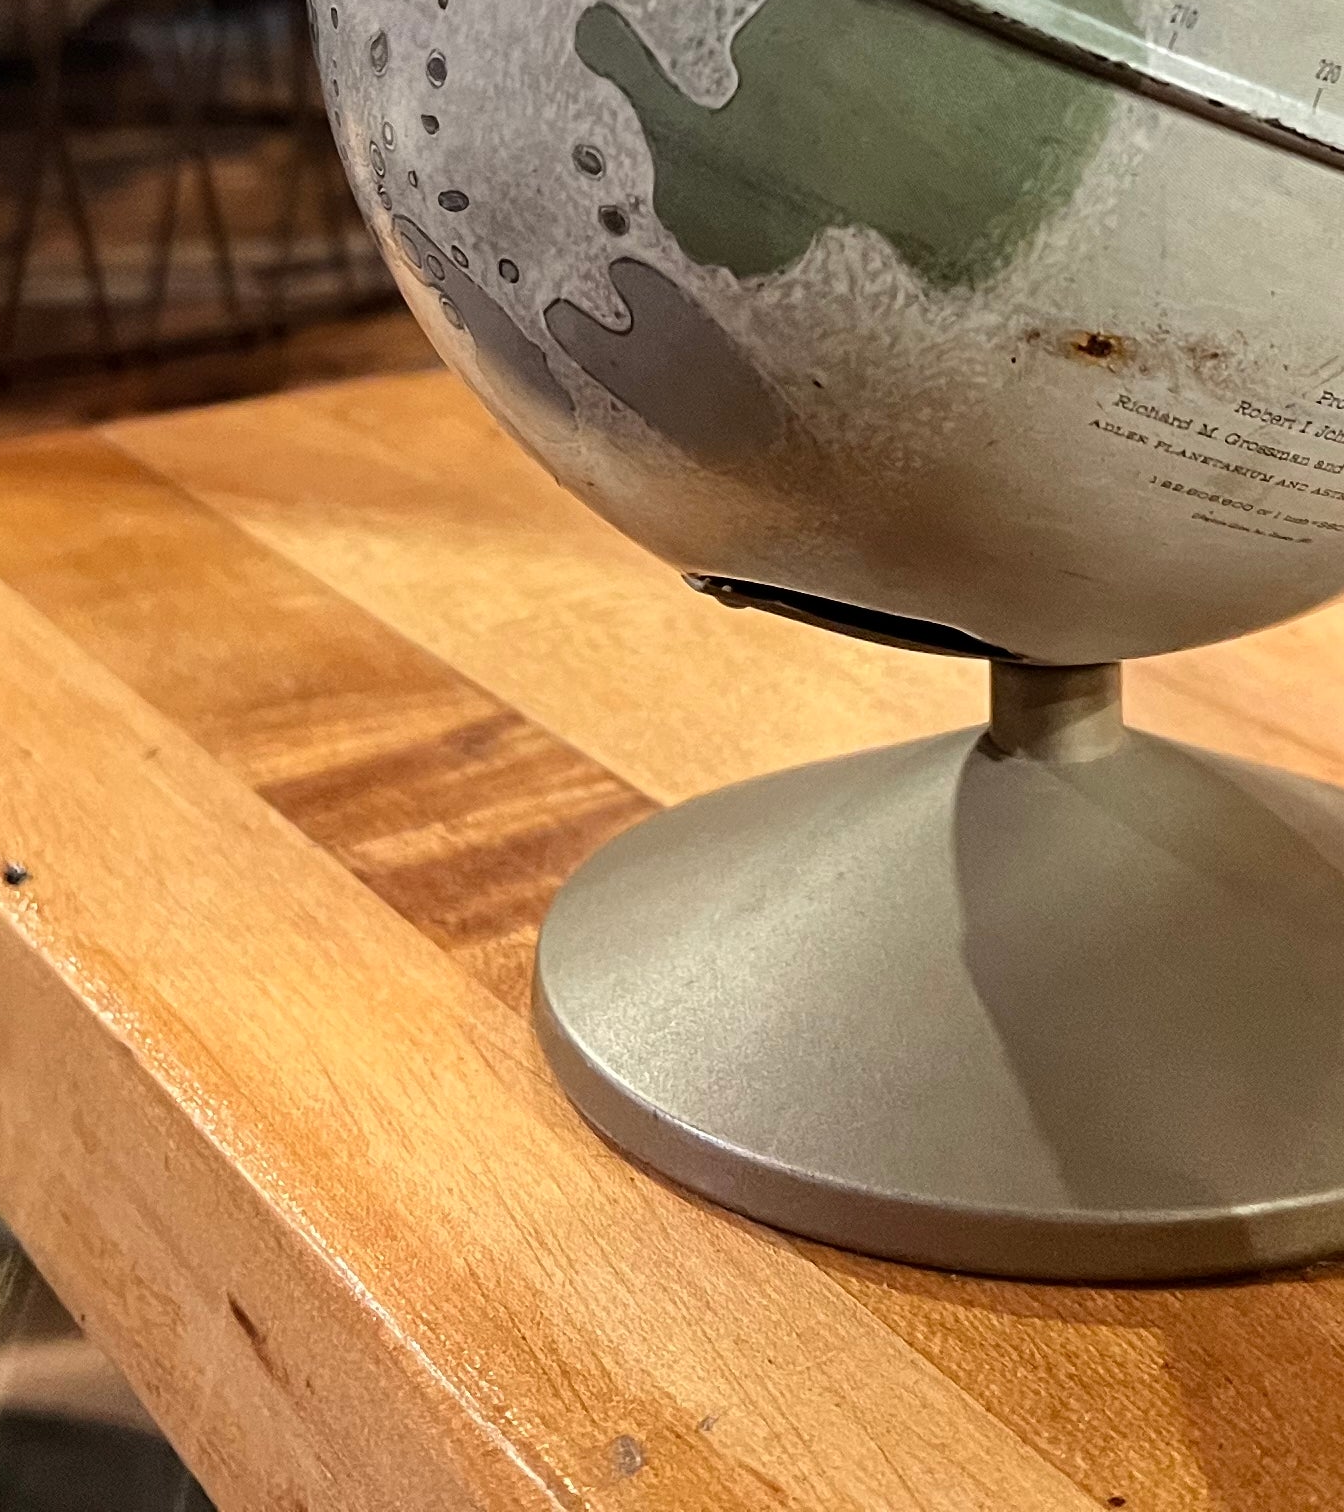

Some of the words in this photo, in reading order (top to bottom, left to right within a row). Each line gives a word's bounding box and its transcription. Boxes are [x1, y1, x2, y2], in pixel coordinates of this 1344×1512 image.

[1113, 394, 1194, 431] Richard
[1224, 432, 1311, 467] Grossman
[1234, 400, 1296, 430] Robert
[1089, 419, 1150, 444] ADLER
[1154, 440, 1275, 483] PLANETARIUM
